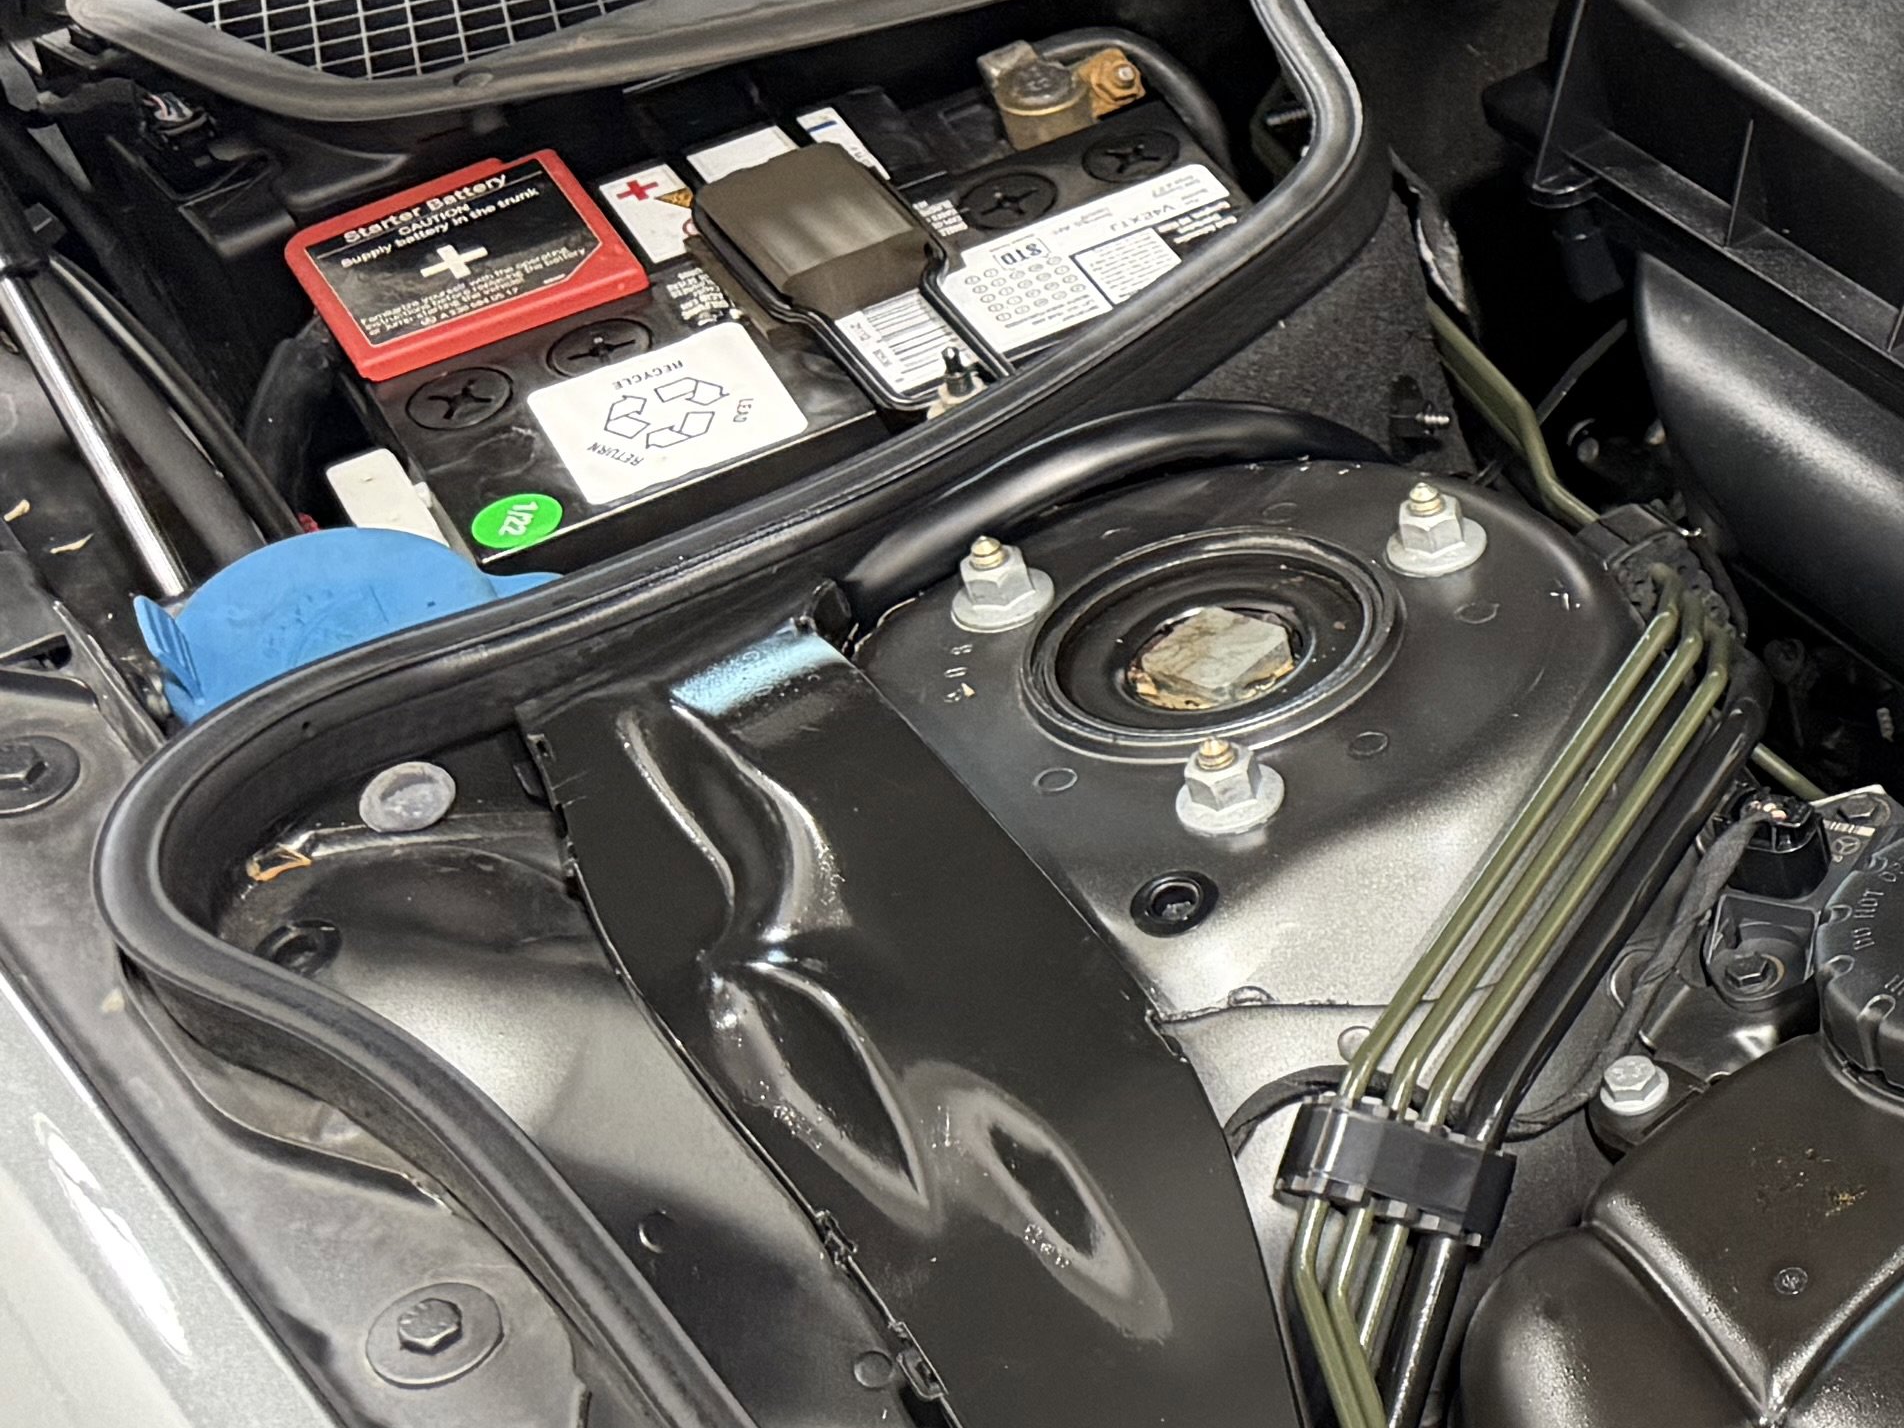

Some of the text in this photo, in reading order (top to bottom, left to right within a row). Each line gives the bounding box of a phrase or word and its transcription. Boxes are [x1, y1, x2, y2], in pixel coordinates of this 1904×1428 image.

[343, 174, 506, 242] Starter Battery
[398, 203, 471, 236] CAUTION
[341, 187, 539, 270] Supply battery in the trunk
[613, 360, 684, 390] RECYCLE
[589, 442, 645, 467] RETURN
